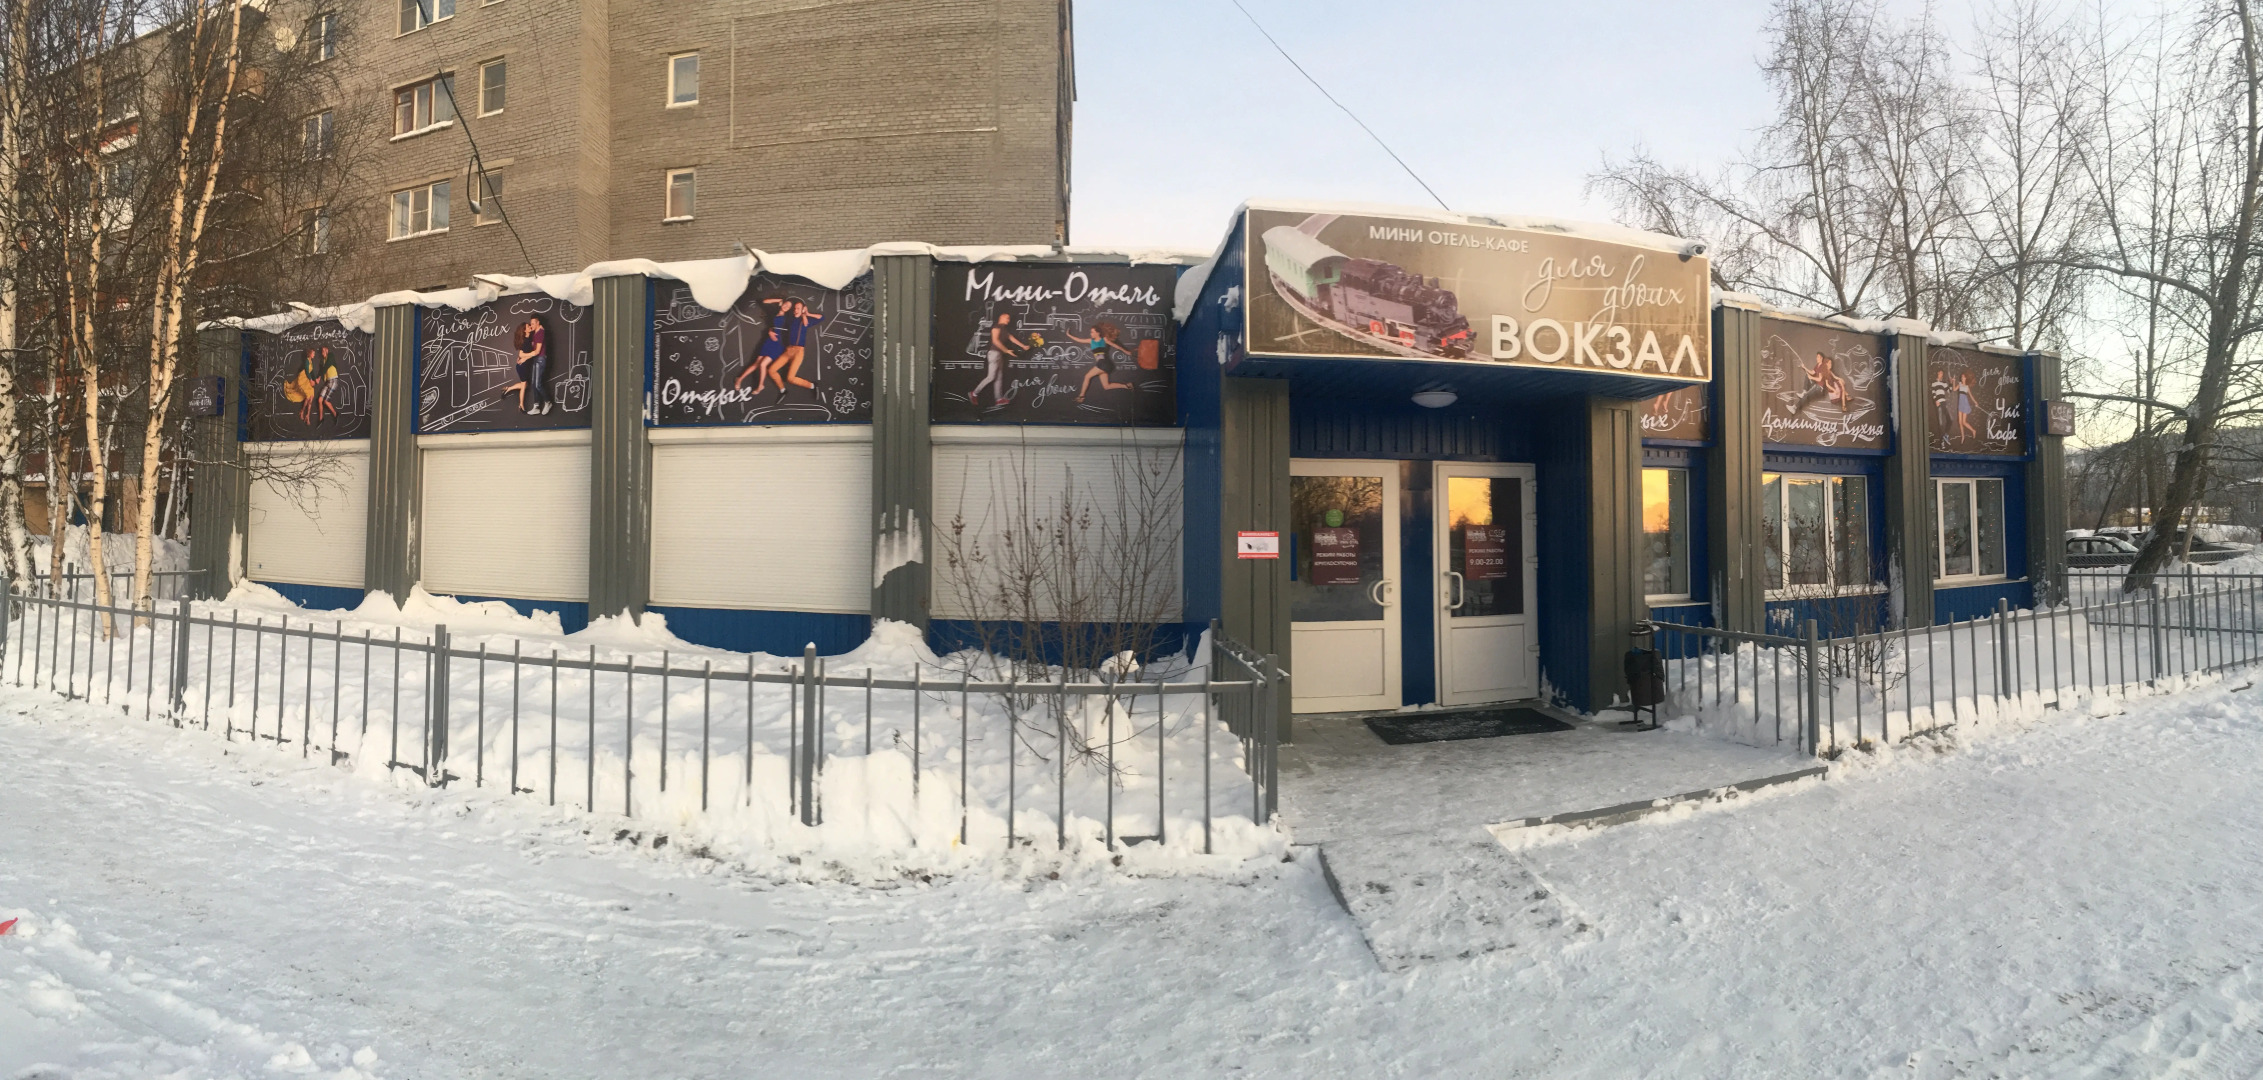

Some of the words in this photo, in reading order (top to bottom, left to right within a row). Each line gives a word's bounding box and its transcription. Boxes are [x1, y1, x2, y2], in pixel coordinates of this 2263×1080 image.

[1369, 225, 1423, 244] МИНИ
[1428, 230, 1529, 253] ОТЕЛЬ-КАФЕ
[965, 267, 1161, 306] Мини-Отель
[1521, 255, 1615, 313] для
[1588, 254, 1686, 338] двоих
[431, 318, 476, 354] для
[459, 311, 511, 361] двоих
[1491, 314, 1704, 376] ВОКЗАЛ
[661, 378, 753, 416] Отдых
[1003, 376, 1044, 401] для
[1032, 373, 1077, 408] двоих
[1761, 406, 1838, 438] Домашняя
[1842, 413, 1885, 443] Кухня
[1995, 398, 2021, 420] Чай
[1986, 418, 2018, 446] Кофе
